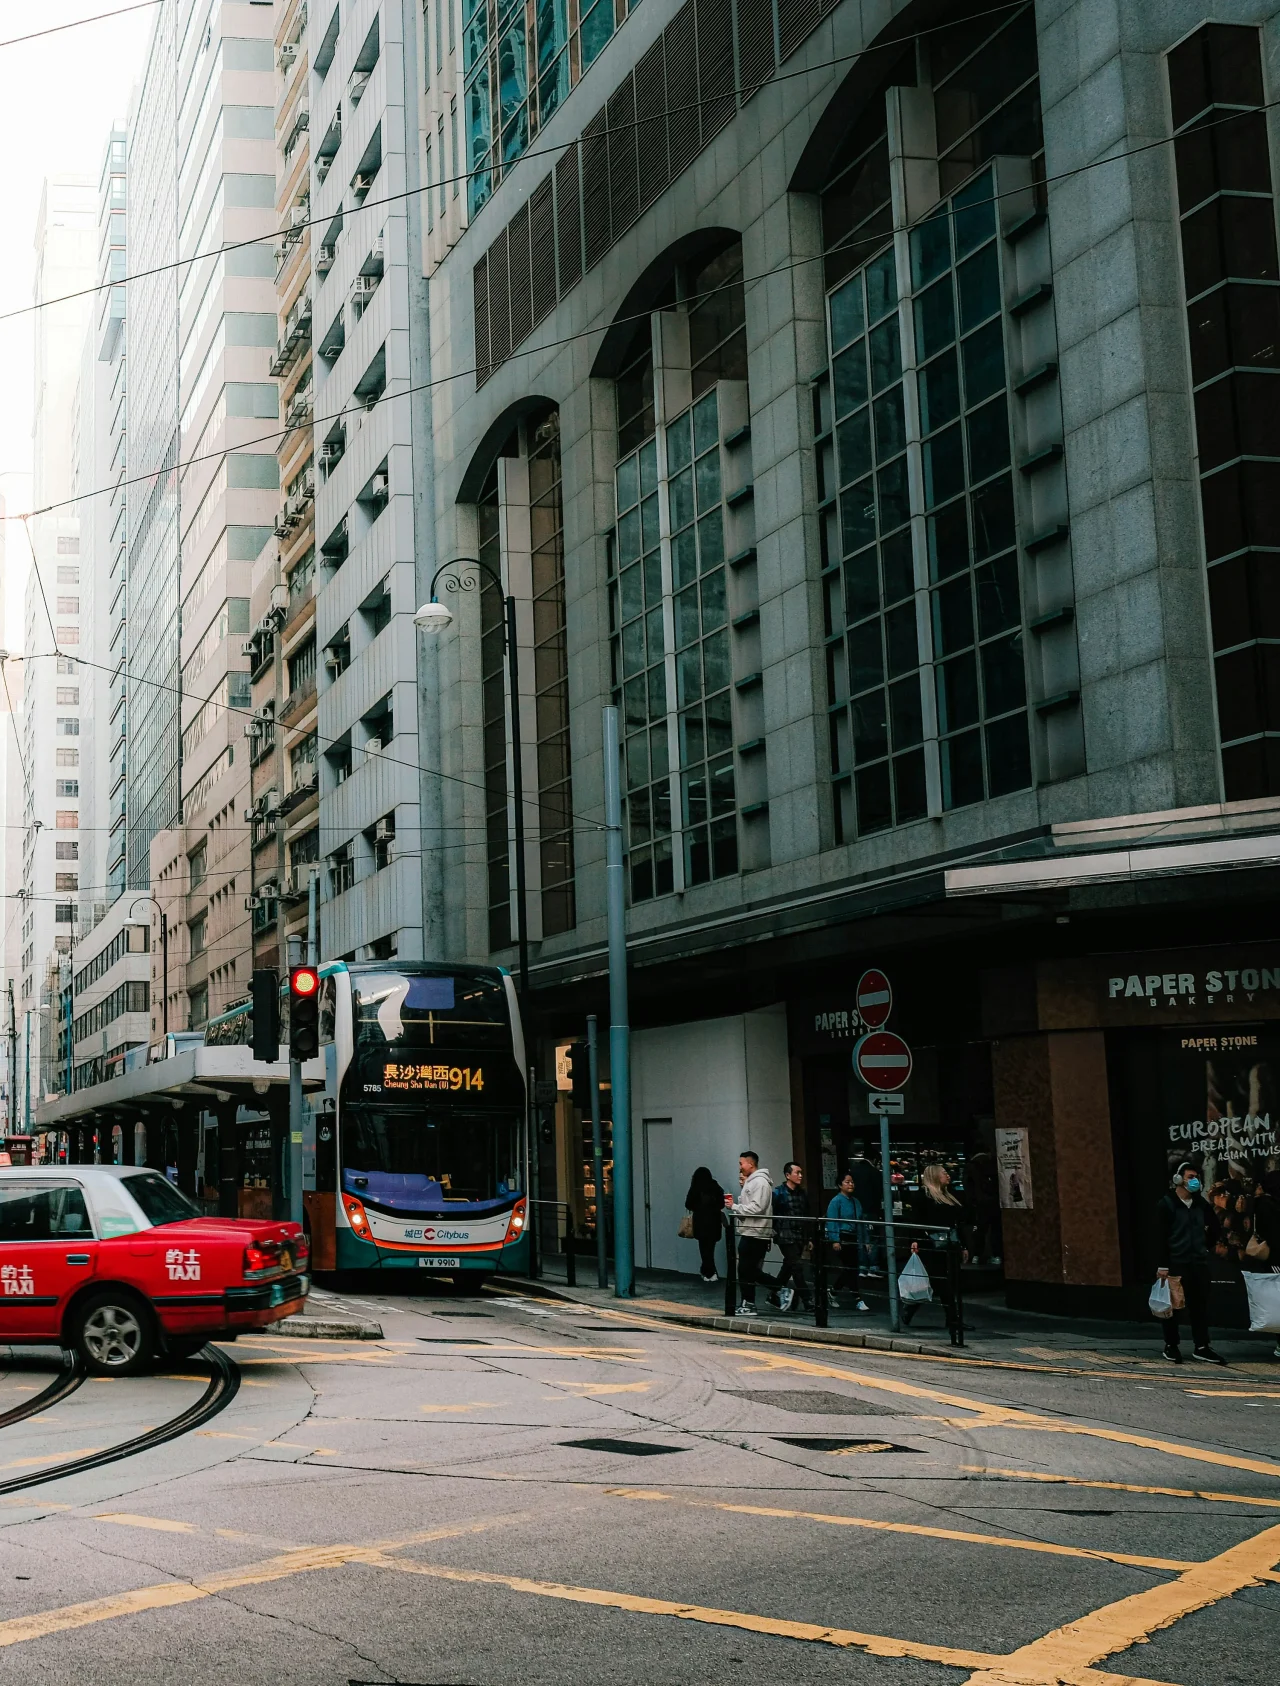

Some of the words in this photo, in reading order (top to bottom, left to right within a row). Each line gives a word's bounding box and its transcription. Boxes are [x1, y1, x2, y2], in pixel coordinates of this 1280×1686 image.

[1108, 973, 1196, 998] PAPER
[1149, 992, 1255, 1007] BAKERY
[815, 1011, 848, 1031] PAPER
[1181, 1038, 1218, 1049] PAPER
[1221, 1035, 1258, 1047] STONE
[384, 1064, 449, 1081] 長沙灣西
[449, 1067, 484, 1091] 914
[384, 1080, 408, 1090] Cheung
[410, 1080, 423, 1089] Sha
[363, 1084, 382, 1092] 5785
[1169, 1112, 1271, 1142] EUROPEAN
[1191, 1137, 1233, 1153] BREAD
[1240, 1131, 1276, 1148] WITH
[1218, 1149, 1248, 1161] ASIAN
[436, 1229, 470, 1240] Citybus
[165, 1248, 201, 1264] 的士
[423, 1258, 435, 1267] VW
[437, 1258, 456, 1267] 9910
[1, 1264, 34, 1279] 的士
[165, 1265, 201, 1281] TAXI
[1, 1280, 34, 1295] TAXI
